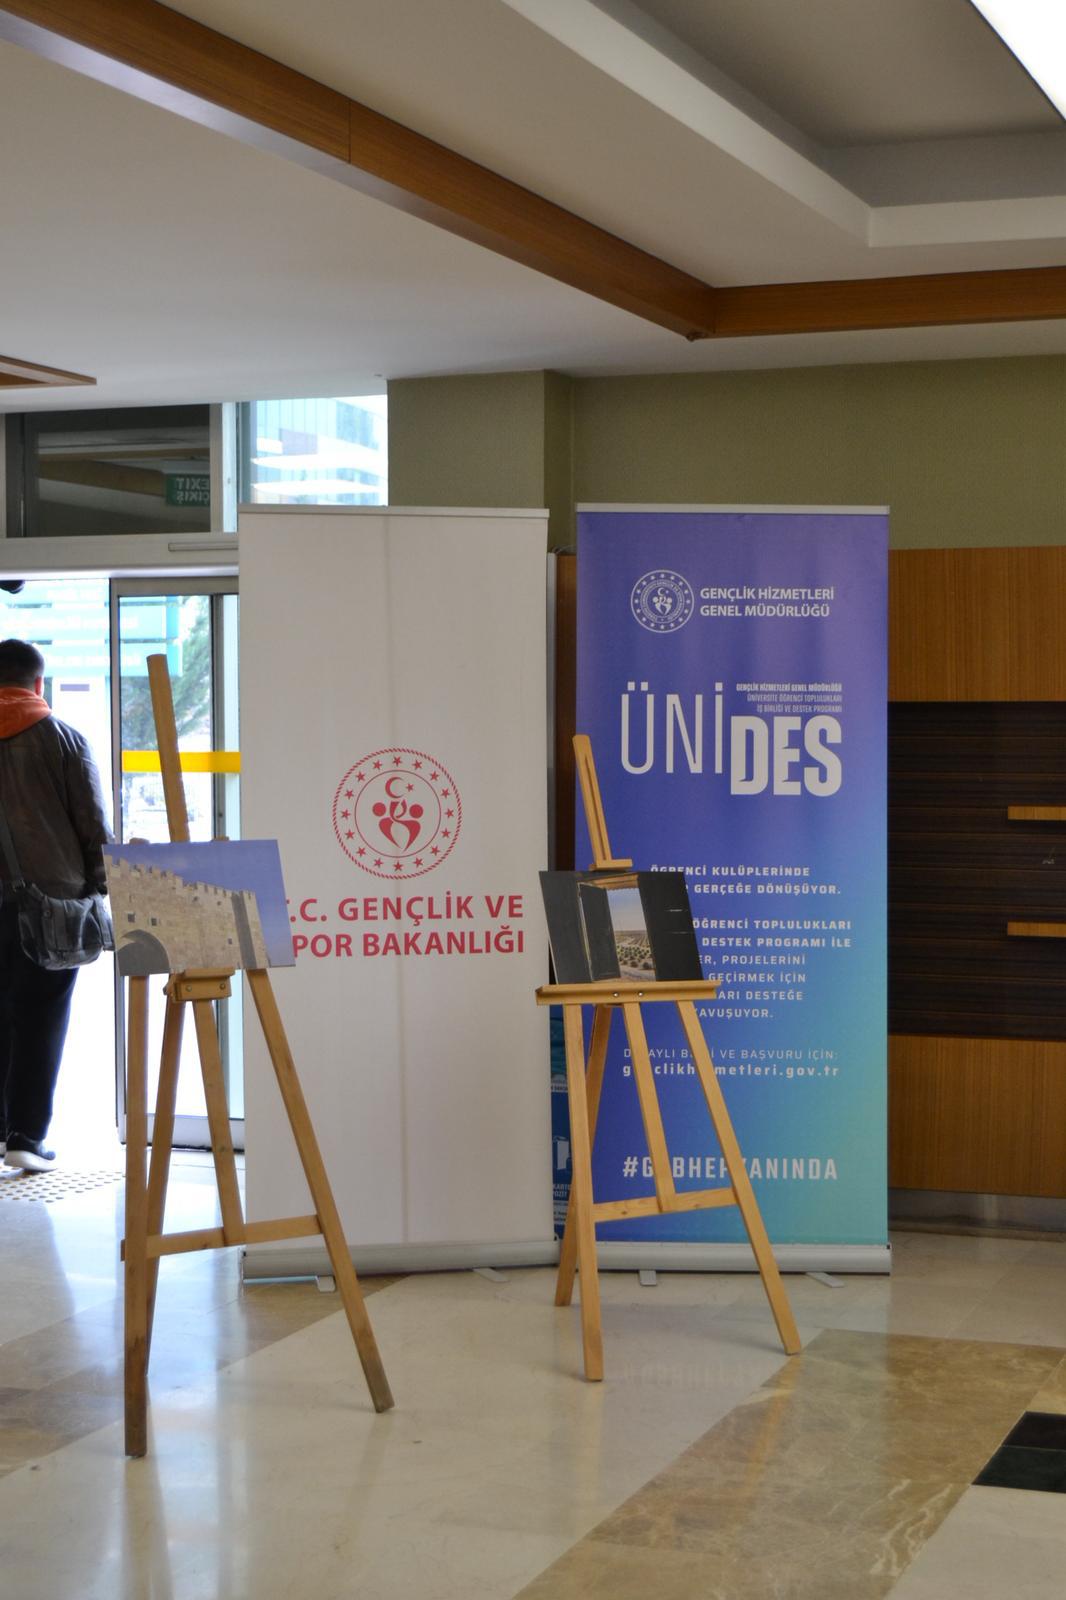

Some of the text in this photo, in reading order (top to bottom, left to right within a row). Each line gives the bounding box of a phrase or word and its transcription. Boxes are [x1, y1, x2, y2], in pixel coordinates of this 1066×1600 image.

[700, 586, 834, 601] GENÇLİK HİZMETLERİ
[700, 603, 830, 617] GENEL MÜDÜRLÜĞÜ
[712, 865, 810, 877] KULÜPLERİNDE
[694, 882, 752, 896] GERÇEĞE
[757, 883, 841, 896] DÖNÜŞÜYOR.
[286, 891, 523, 926] .C. GENÇLİK VE
[692, 917, 851, 930] ÖĞRENCİ TOPLULUKLARI
[292, 925, 524, 958] POR BAKANLIĞI
[702, 936, 852, 947] DESTEK PROGRAMI İLE
[722, 953, 806, 965] PROJELERİNİ
[708, 972, 806, 984] GEÇİRMEK İÇİN
[746, 989, 804, 1001] DESTEĞE
[695, 1008, 774, 1019] AVUŞUYOR.
[720, 1050, 735, 1059] VE
[741, 1050, 803, 1060] BAŞVURU
[808, 1049, 838, 1061] İÇİN:
[623, 1064, 839, 1079] gclikhmetleri.gov.tr
